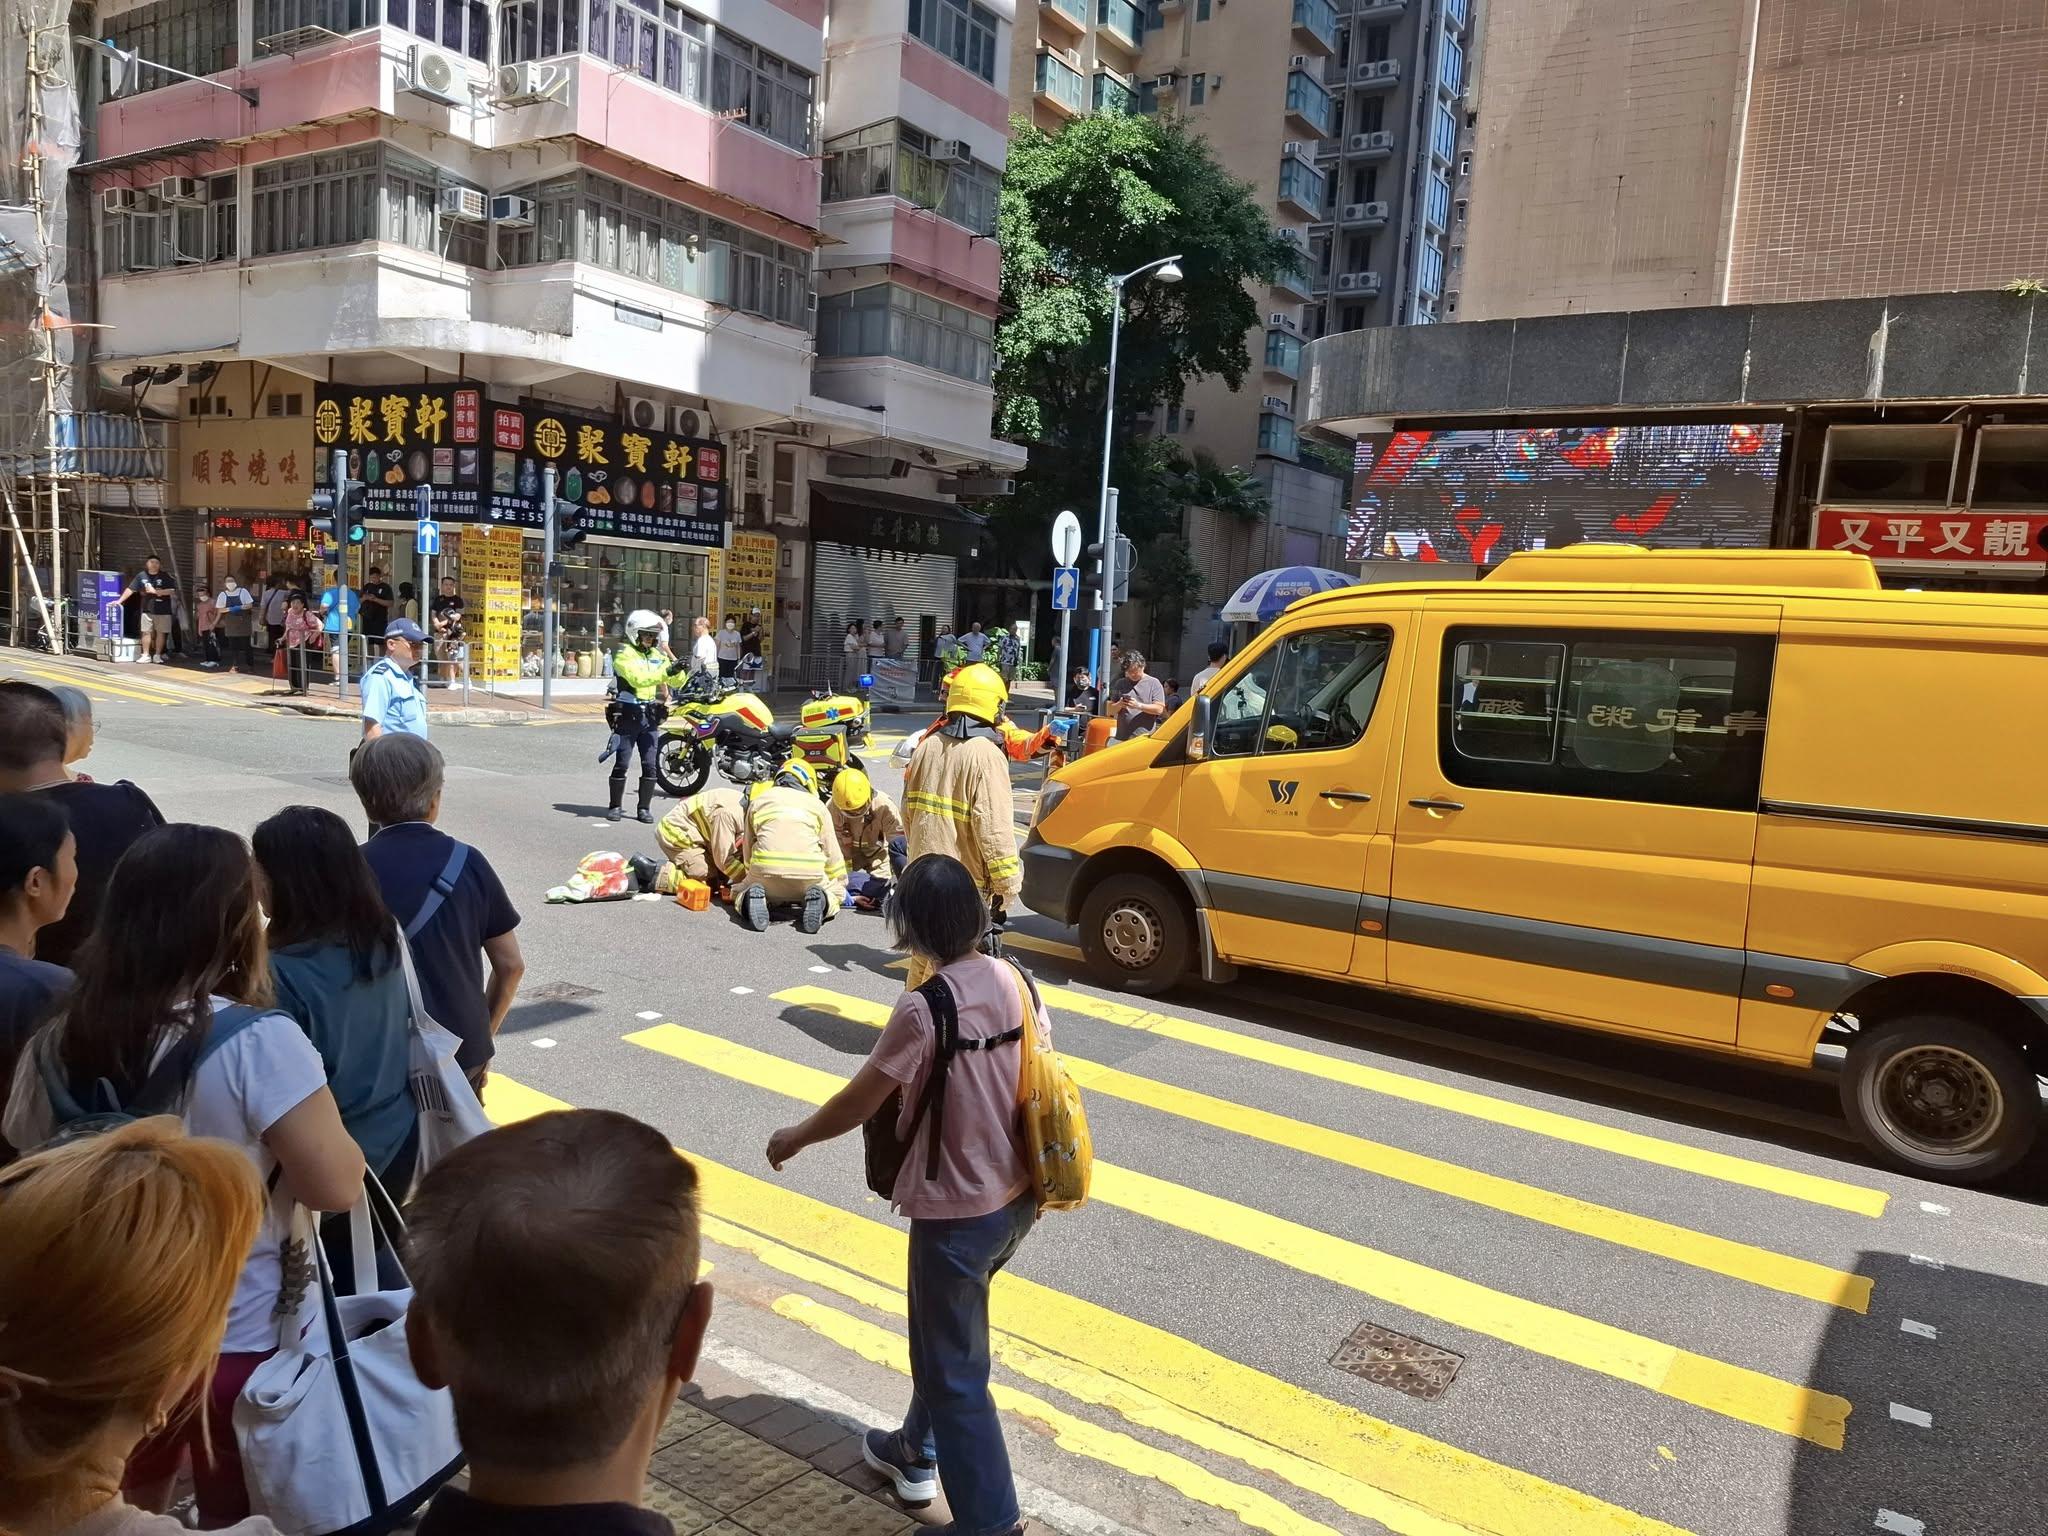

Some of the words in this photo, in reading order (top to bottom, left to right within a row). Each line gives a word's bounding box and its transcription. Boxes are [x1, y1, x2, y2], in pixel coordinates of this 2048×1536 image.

[349, 394, 447, 445] 聚寶軒
[456, 426, 475, 438] 回收
[192, 448, 299, 486] 順發燒味
[576, 425, 693, 479] 聚寶軒
[1832, 519, 2030, 556] 又平又靚
